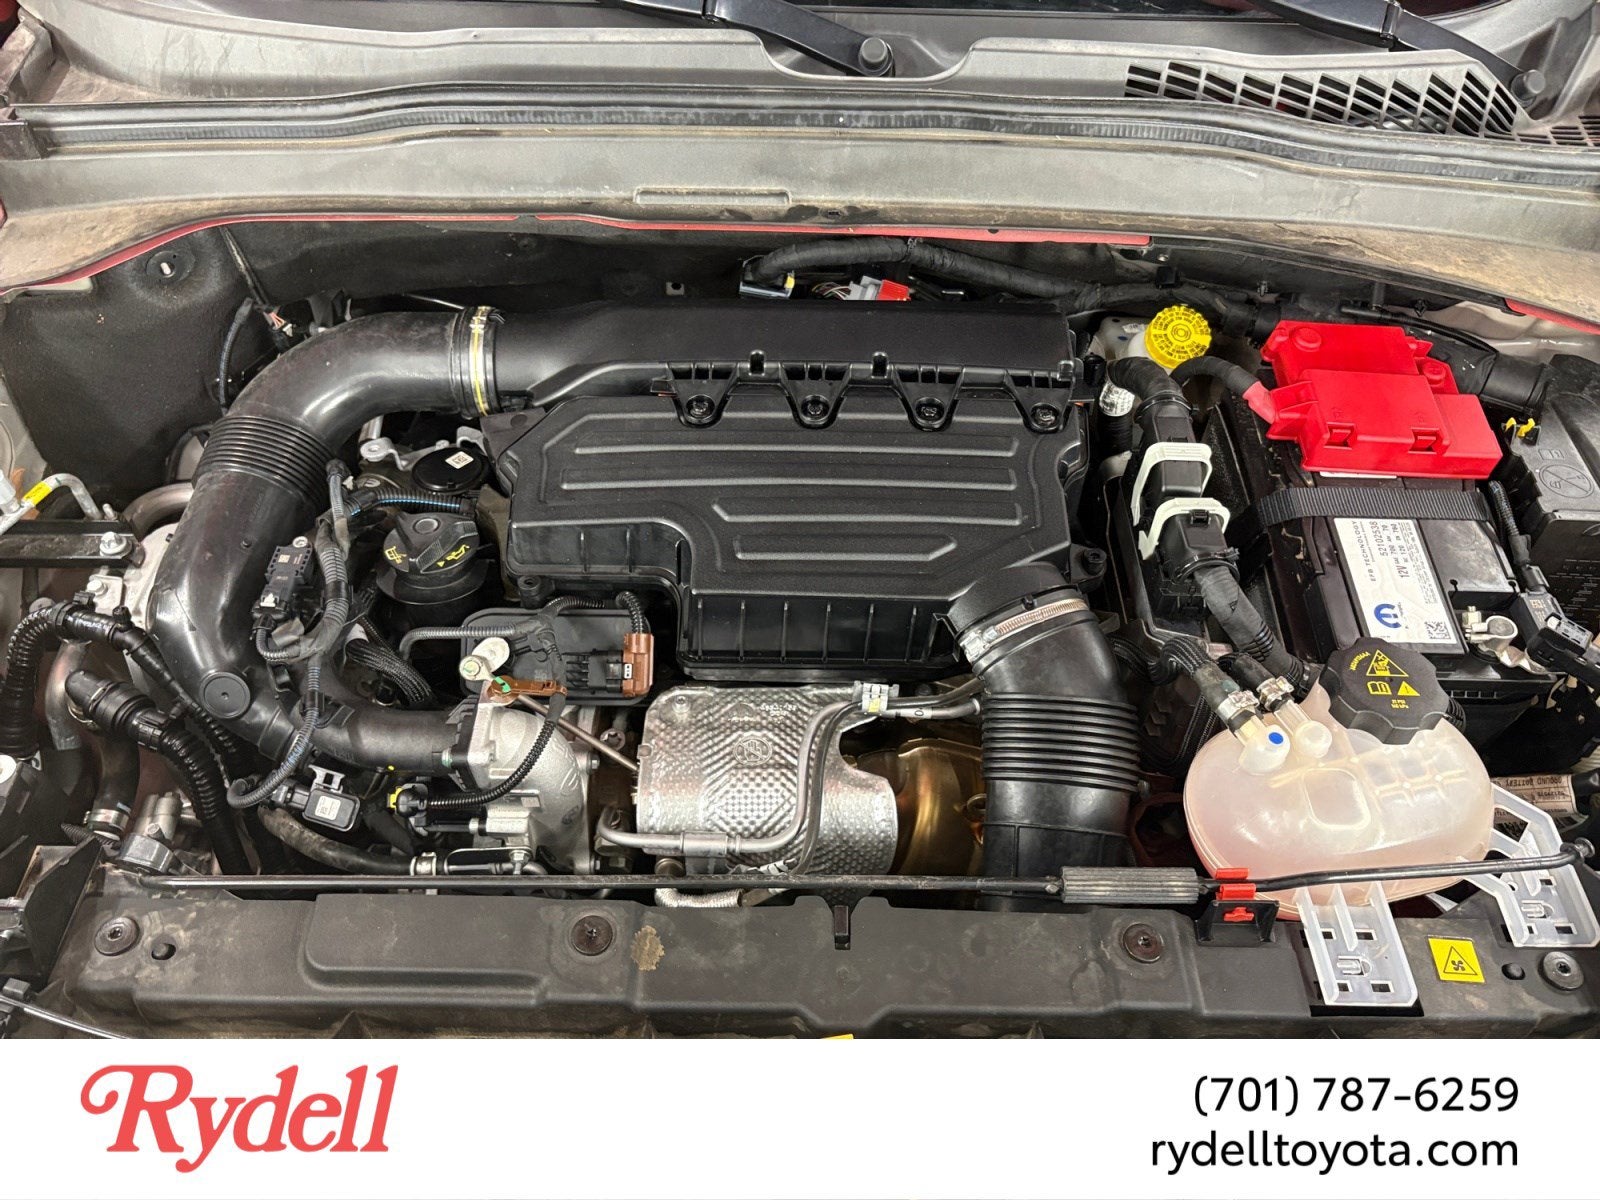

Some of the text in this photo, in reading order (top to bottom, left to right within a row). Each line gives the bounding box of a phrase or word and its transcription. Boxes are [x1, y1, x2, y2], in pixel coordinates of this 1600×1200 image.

[1351, 520, 1371, 566] TECHNOLOGY
[1396, 565, 1410, 578] 12V
[1505, 778, 1533, 787] BATTERY
